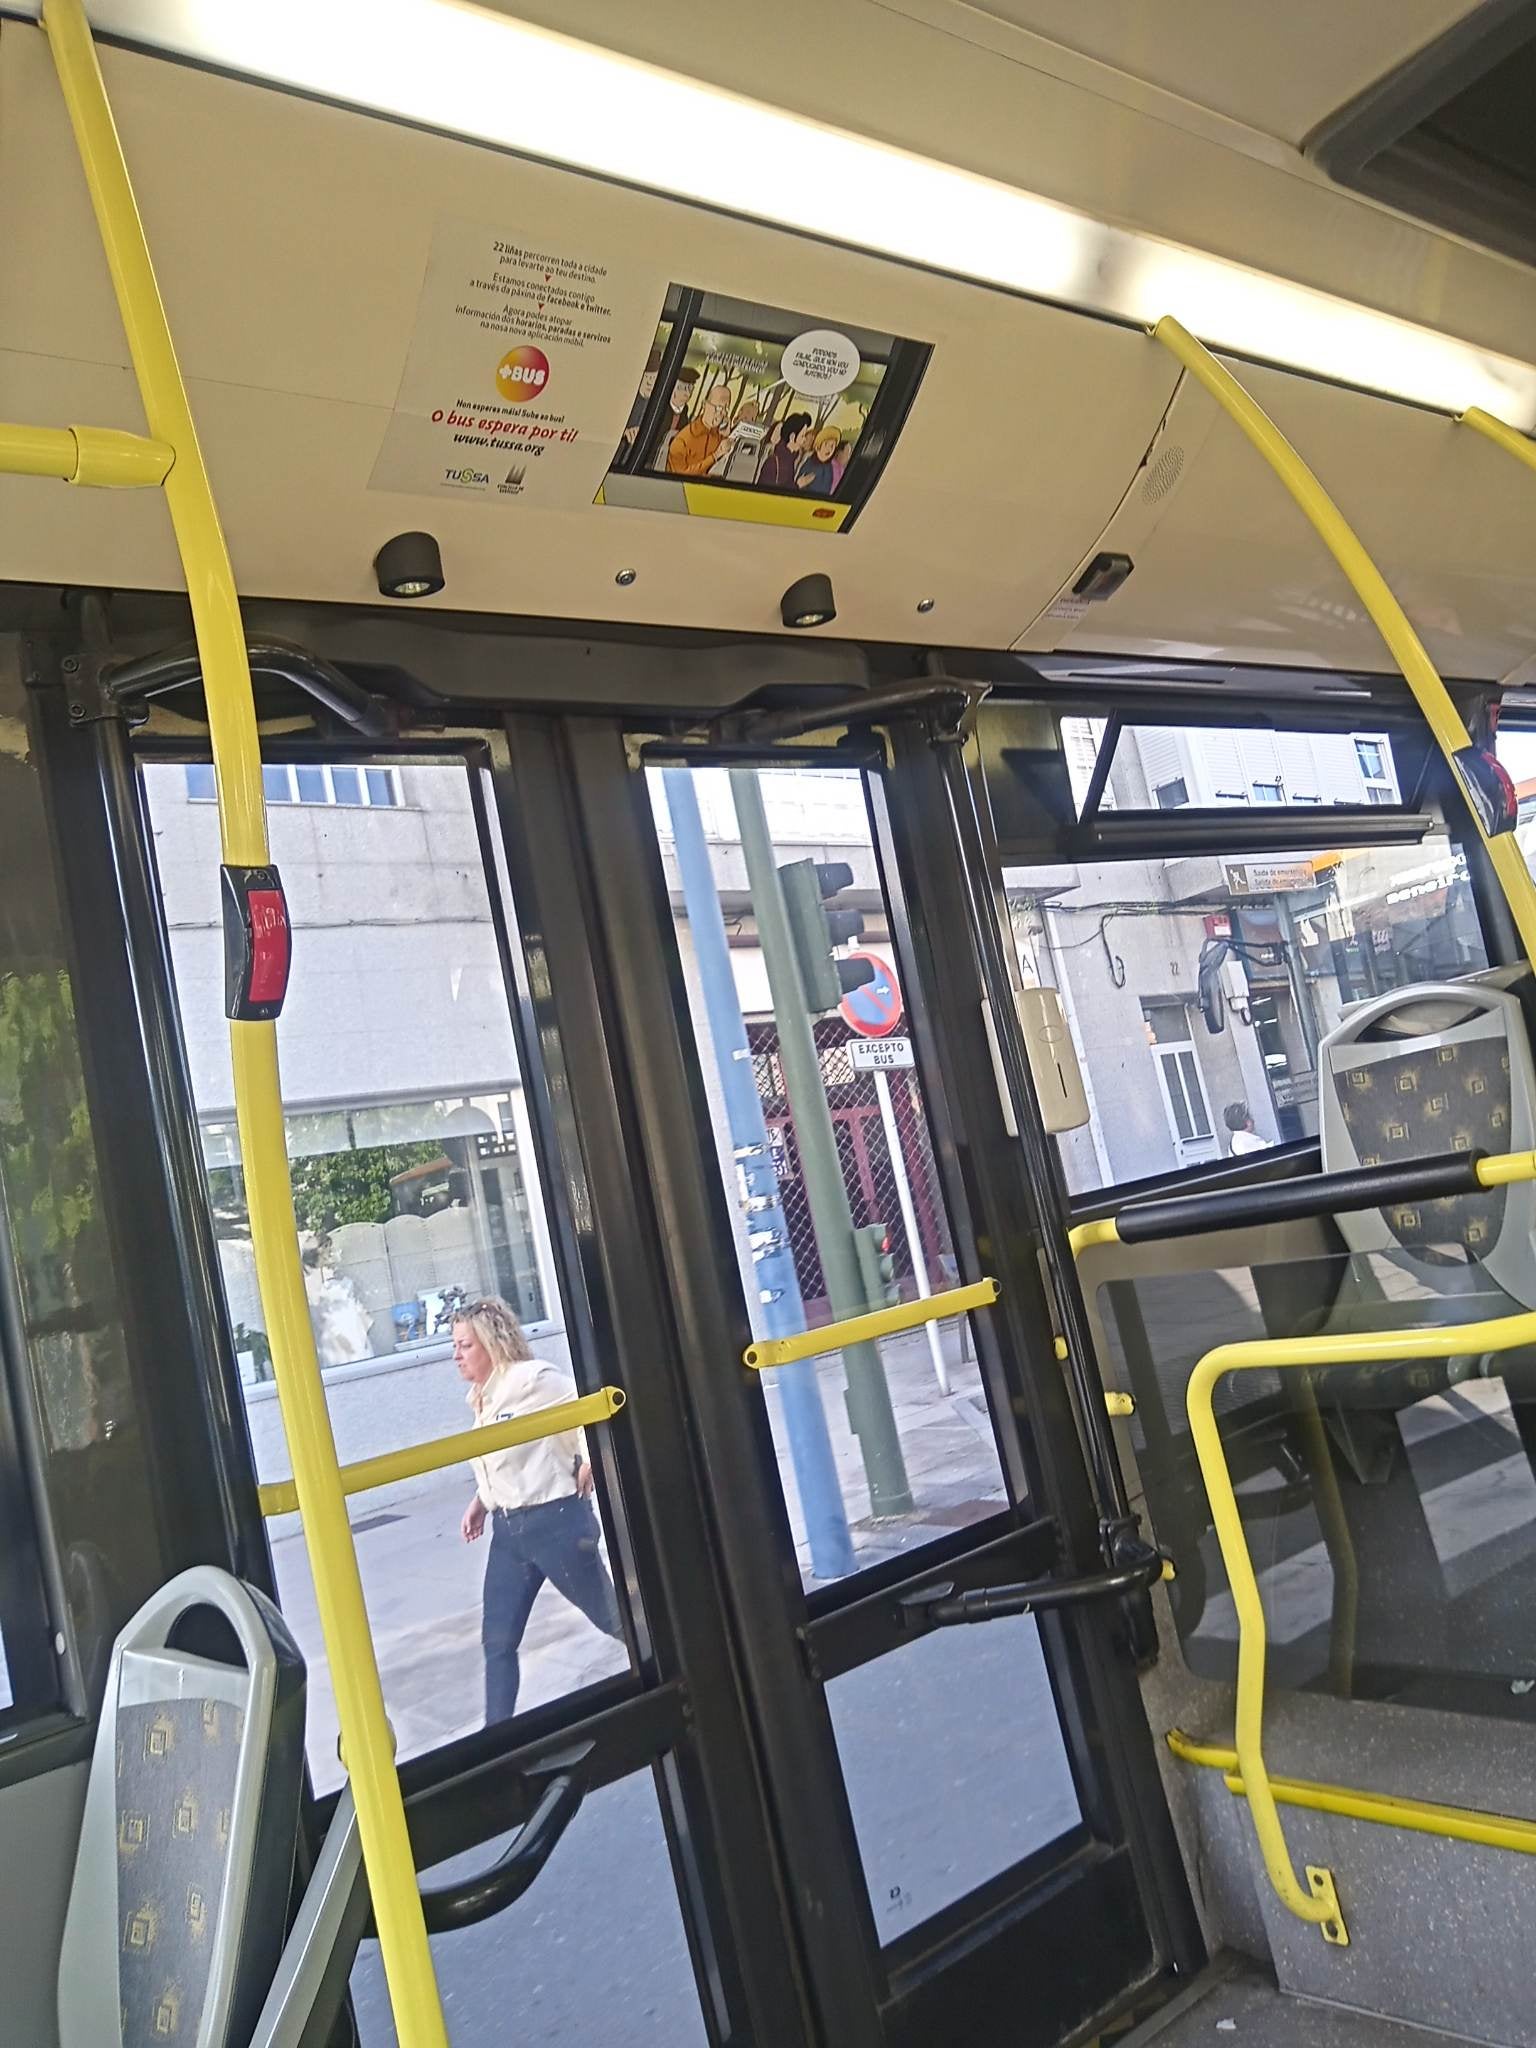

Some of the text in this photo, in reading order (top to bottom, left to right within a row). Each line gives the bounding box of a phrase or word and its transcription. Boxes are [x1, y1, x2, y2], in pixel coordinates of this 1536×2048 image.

[493, 241, 505, 252] 22
[523, 250, 560, 265] percorren
[561, 258, 577, 270] toda
[584, 263, 607, 276] cidade
[500, 255, 516, 266] para
[518, 258, 544, 272] levarte
[556, 267, 568, 278] teu
[476, 280, 500, 293] través
[501, 284, 510, 295] da
[510, 287, 536, 300] páxina
[536, 292, 546, 302] de
[546, 294, 580, 310] facebook
[586, 302, 612, 317] twitter.
[492, 272, 596, 304] Estamos conectados contigo
[455, 304, 501, 322] información
[502, 314, 516, 326] dos
[516, 316, 547, 332] horarios,
[548, 324, 576, 338] paradas
[583, 330, 612, 344] servizos
[502, 304, 573, 327] Agora podes atopar
[480, 320, 490, 329] na
[490, 322, 508, 333] nosa
[508, 326, 527, 336] nova
[528, 329, 563, 344] aplicación
[456, 399, 472, 410] Non
[431, 409, 579, 444] O bus espera por ti!
[453, 433, 546, 457] www.tussa.org
[445, 467, 490, 484] TUSSA
[858, 1042, 904, 1054] EXCEPTO
[873, 1054, 894, 1065] BUS
